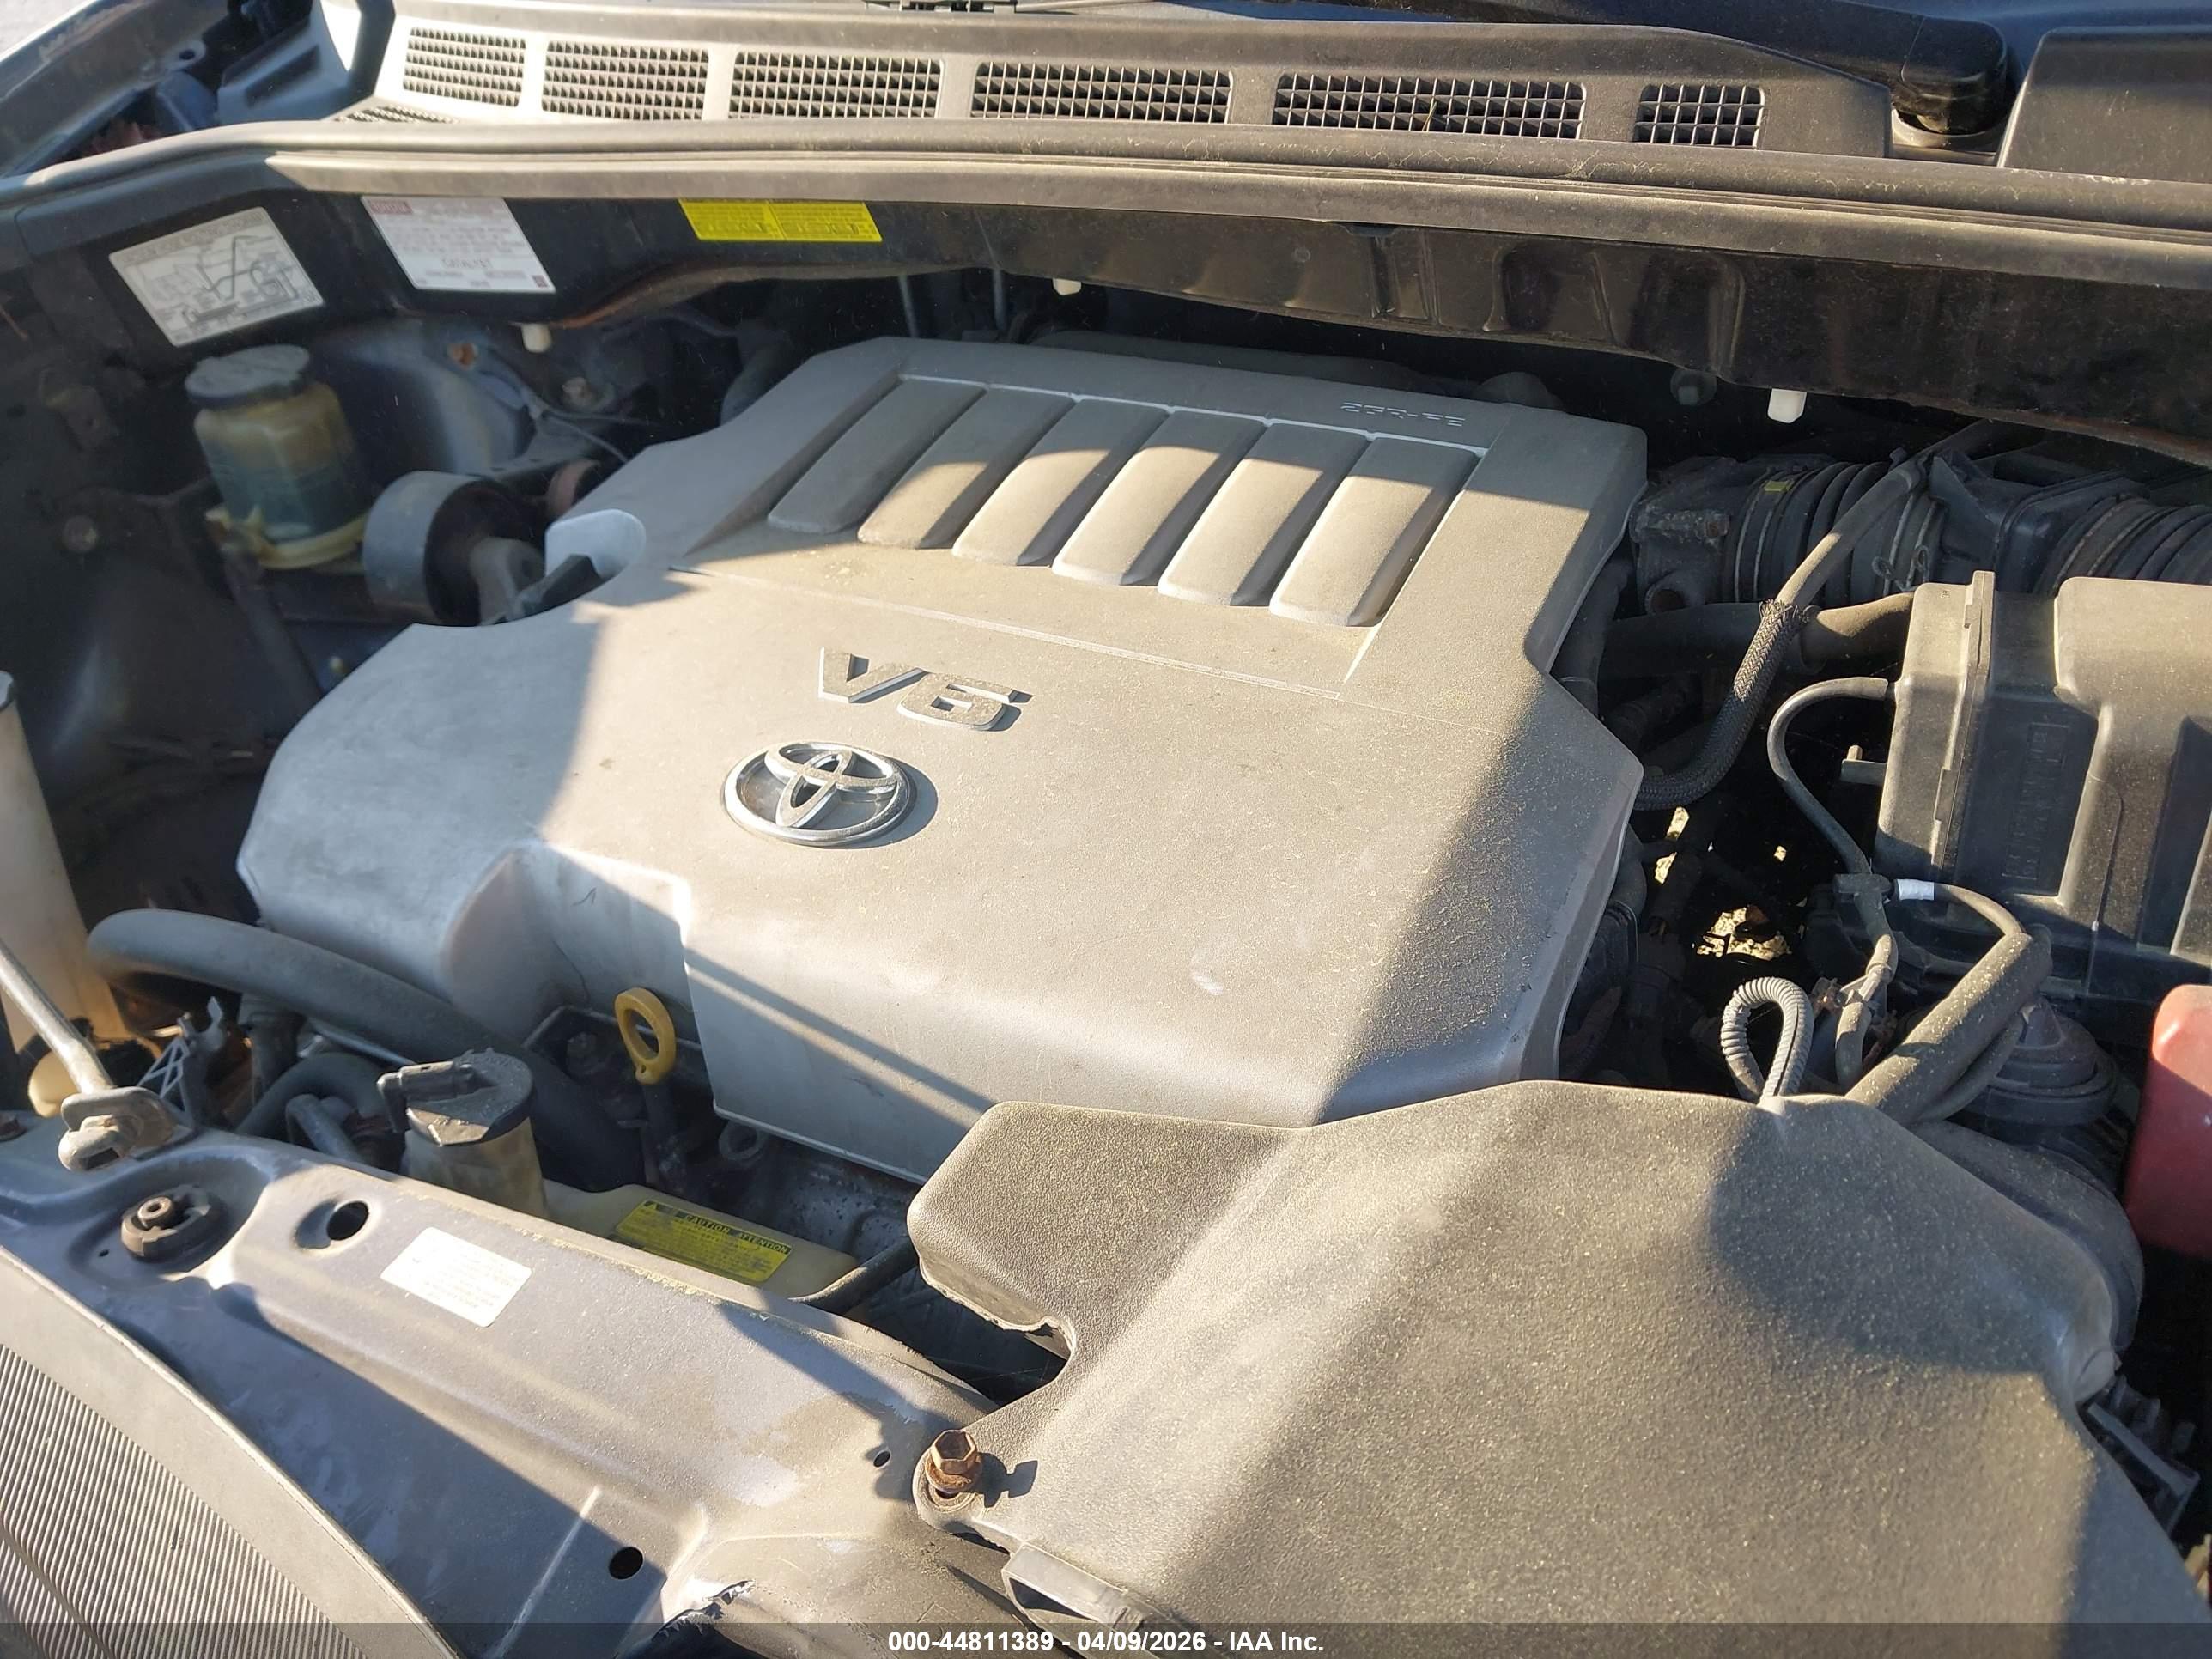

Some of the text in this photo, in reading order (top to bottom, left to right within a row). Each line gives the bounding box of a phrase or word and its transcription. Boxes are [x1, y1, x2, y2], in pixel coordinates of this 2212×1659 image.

[817, 647, 1027, 731] V6
[686, 1213, 788, 1255] CAUTION ATTENTION
